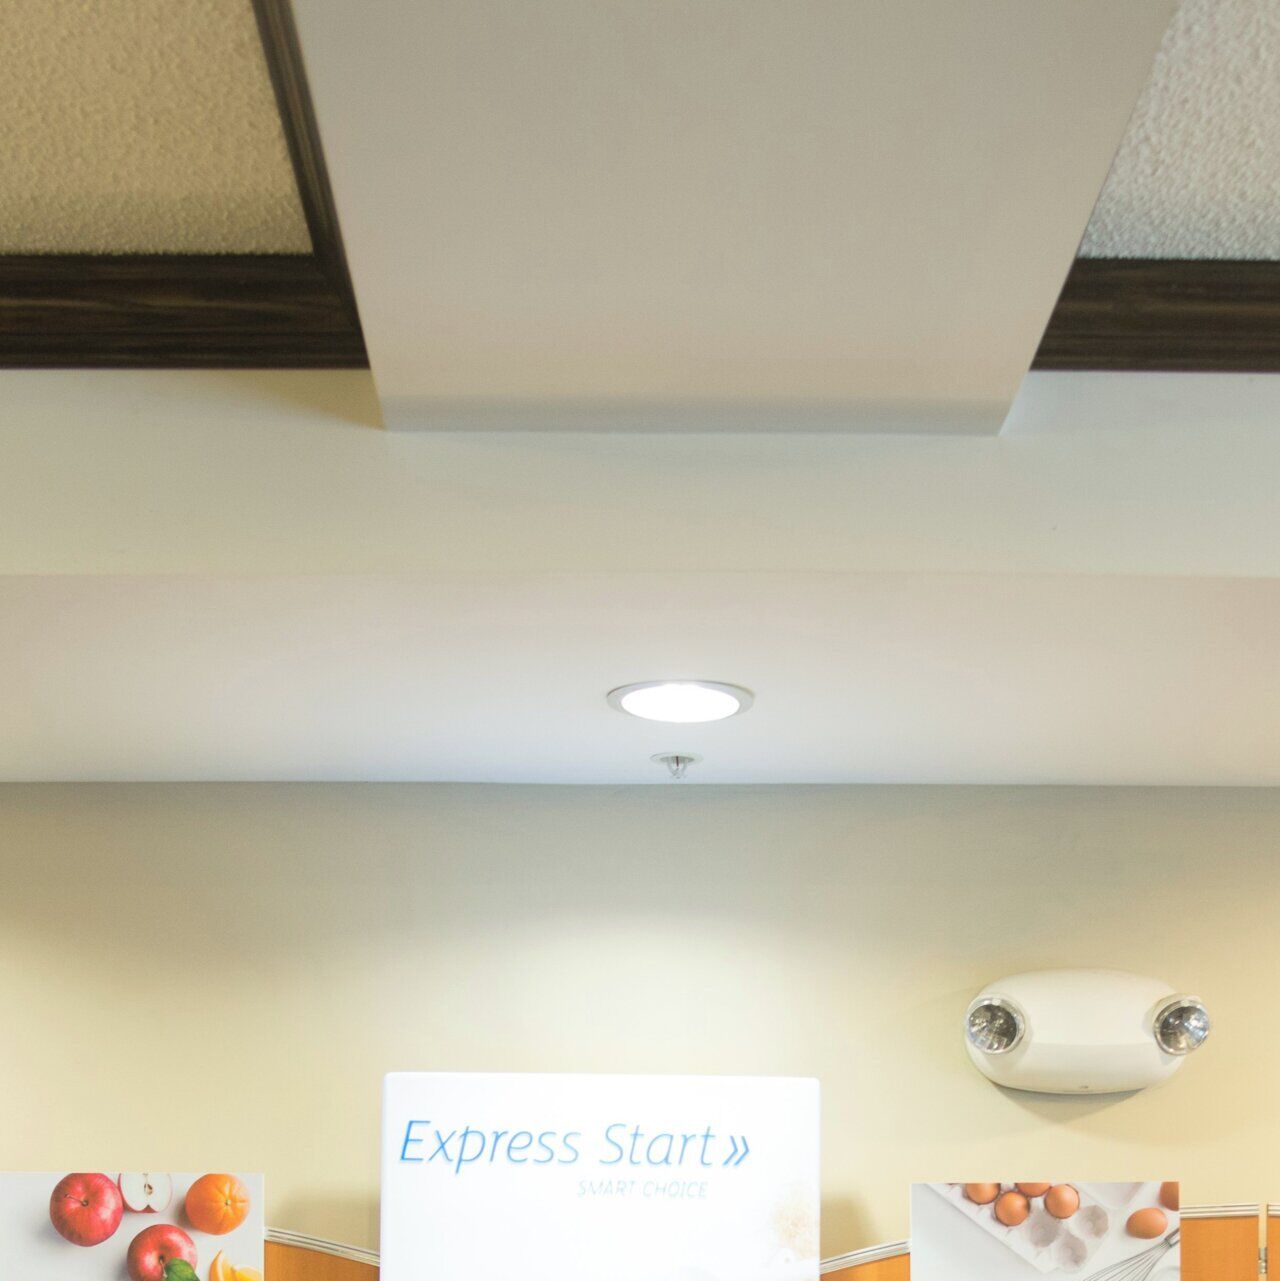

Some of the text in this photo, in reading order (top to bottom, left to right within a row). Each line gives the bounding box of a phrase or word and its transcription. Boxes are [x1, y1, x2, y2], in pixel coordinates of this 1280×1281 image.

[399, 1119, 715, 1174] Express Start
[577, 1180, 708, 1198] SMART CHOICE
